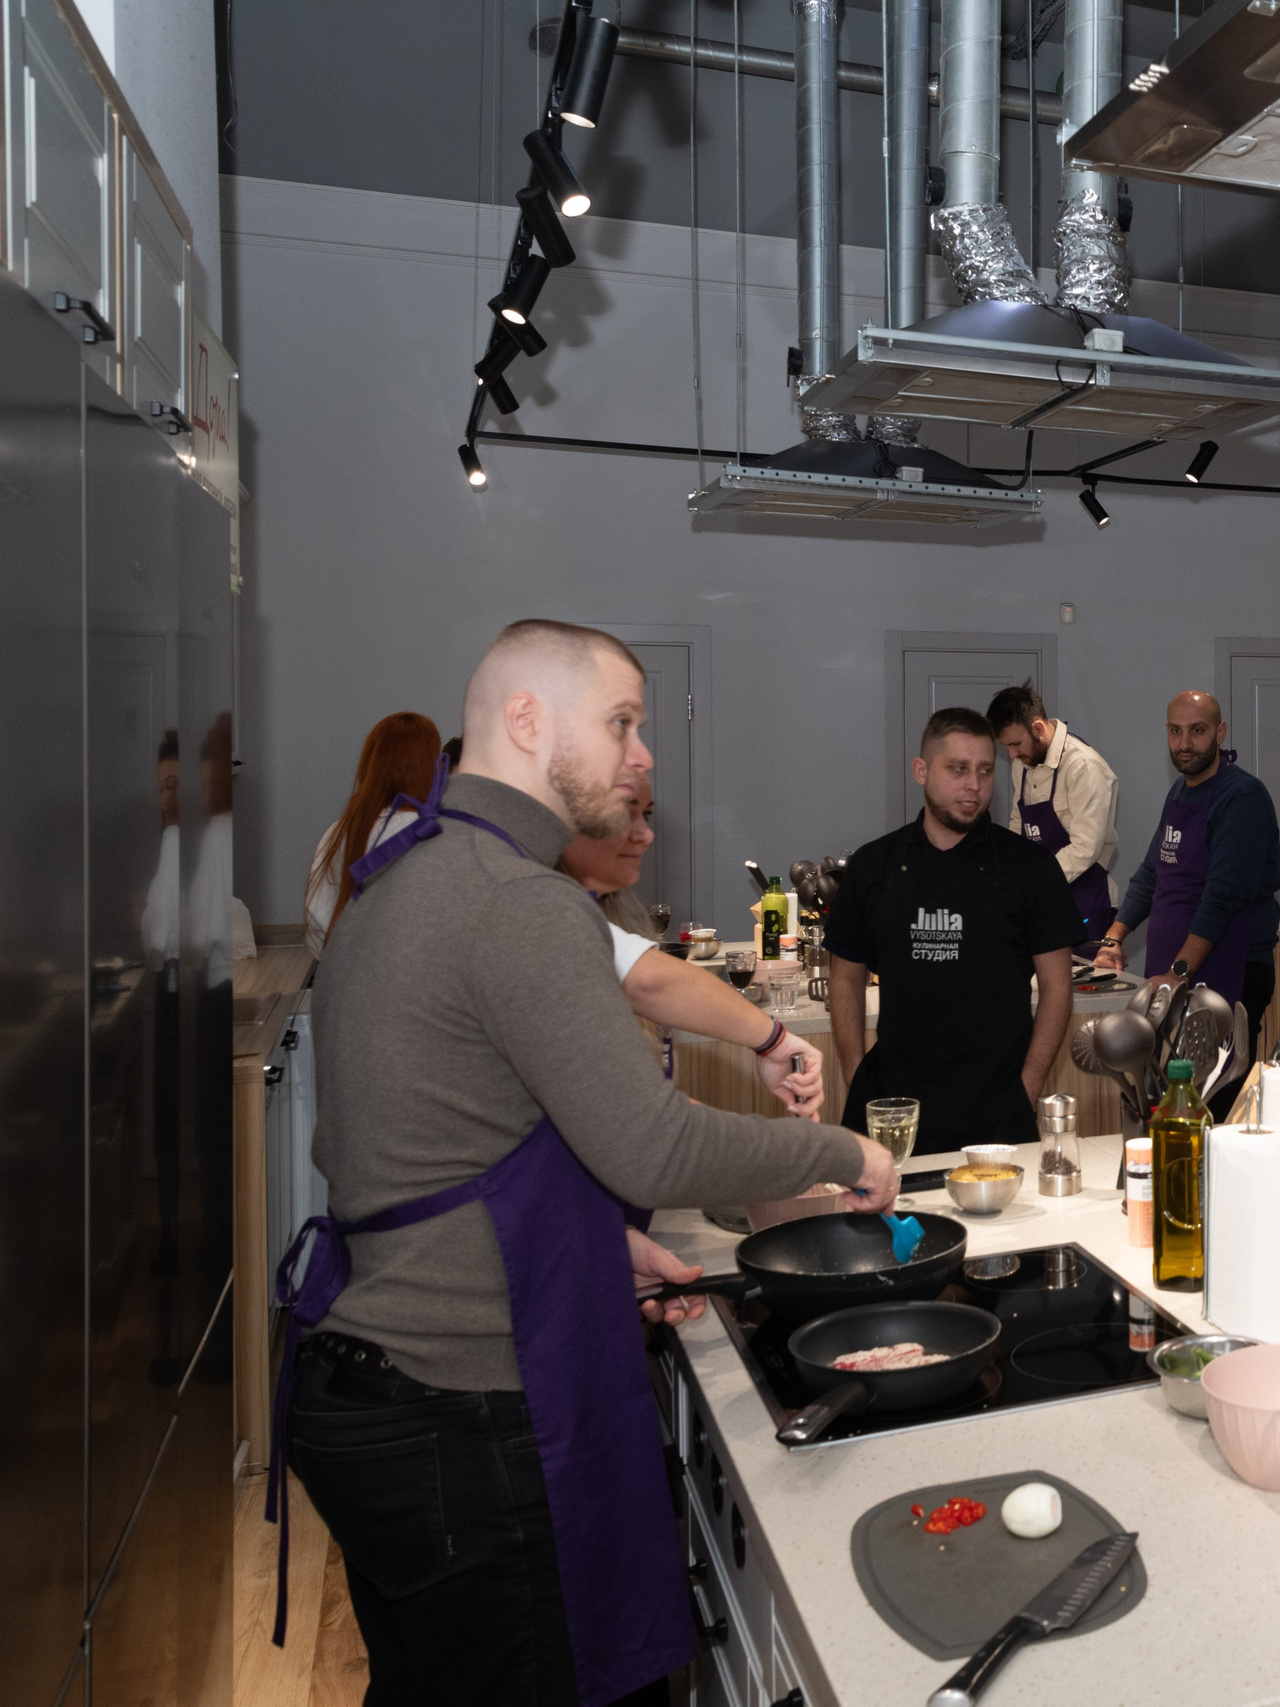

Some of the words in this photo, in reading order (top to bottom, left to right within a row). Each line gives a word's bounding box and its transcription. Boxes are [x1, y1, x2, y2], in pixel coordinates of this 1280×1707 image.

[1023, 822, 1041, 837] lia
[1164, 824, 1182, 843] lia
[910, 907, 963, 931] Julia
[910, 930, 963, 941] VYSOTSKAYA
[912, 942, 959, 950] КУЛИНАРНАЯ
[912, 949, 959, 962] СТУДИЯ
